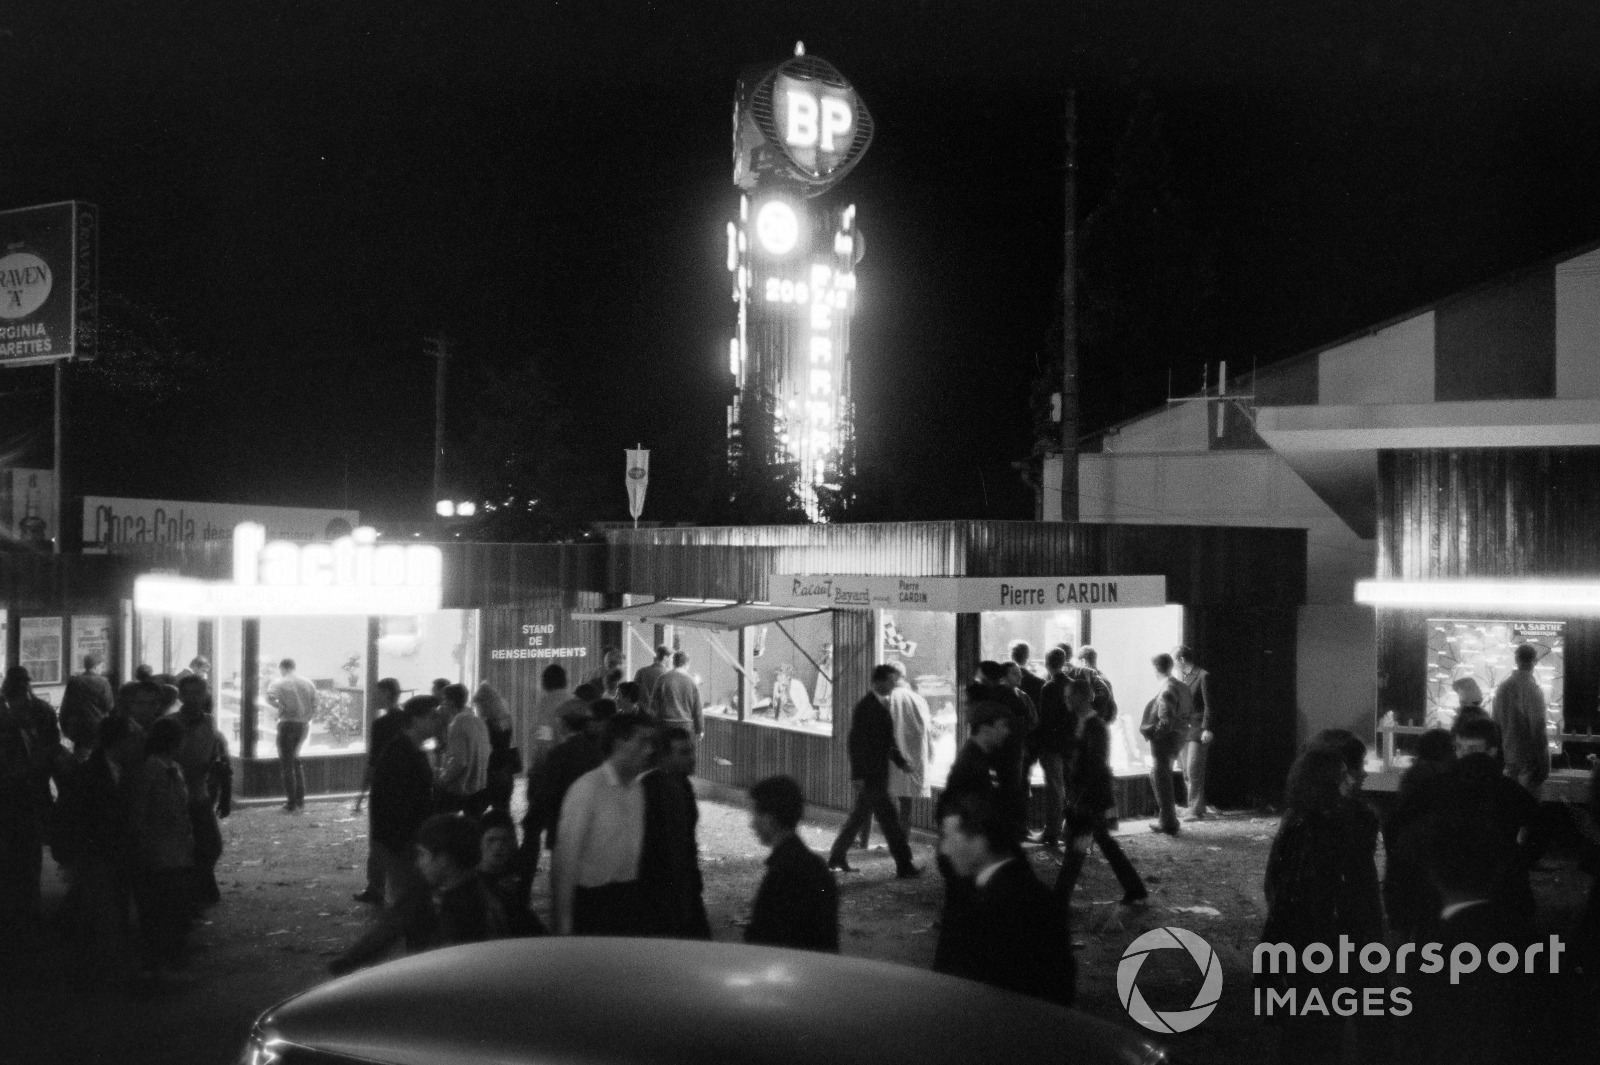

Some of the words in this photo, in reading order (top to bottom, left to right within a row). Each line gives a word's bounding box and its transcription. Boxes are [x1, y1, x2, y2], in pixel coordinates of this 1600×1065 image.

[786, 90, 852, 151] BP
[0, 266, 48, 288] RAVEN
[0, 323, 46, 340] RGINIA
[0, 338, 52, 356] ARETTES
[95, 504, 195, 543] Coca-Cola
[899, 592, 928, 603] CARDIN
[1000, 583, 1046, 605] Pierre
[1057, 582, 1118, 604] CARDIN
[522, 624, 554, 634] STAND
[1514, 623, 1525, 631] LA
[529, 636, 543, 646] DE
[491, 647, 587, 660] RENSEIGNEMENTS
